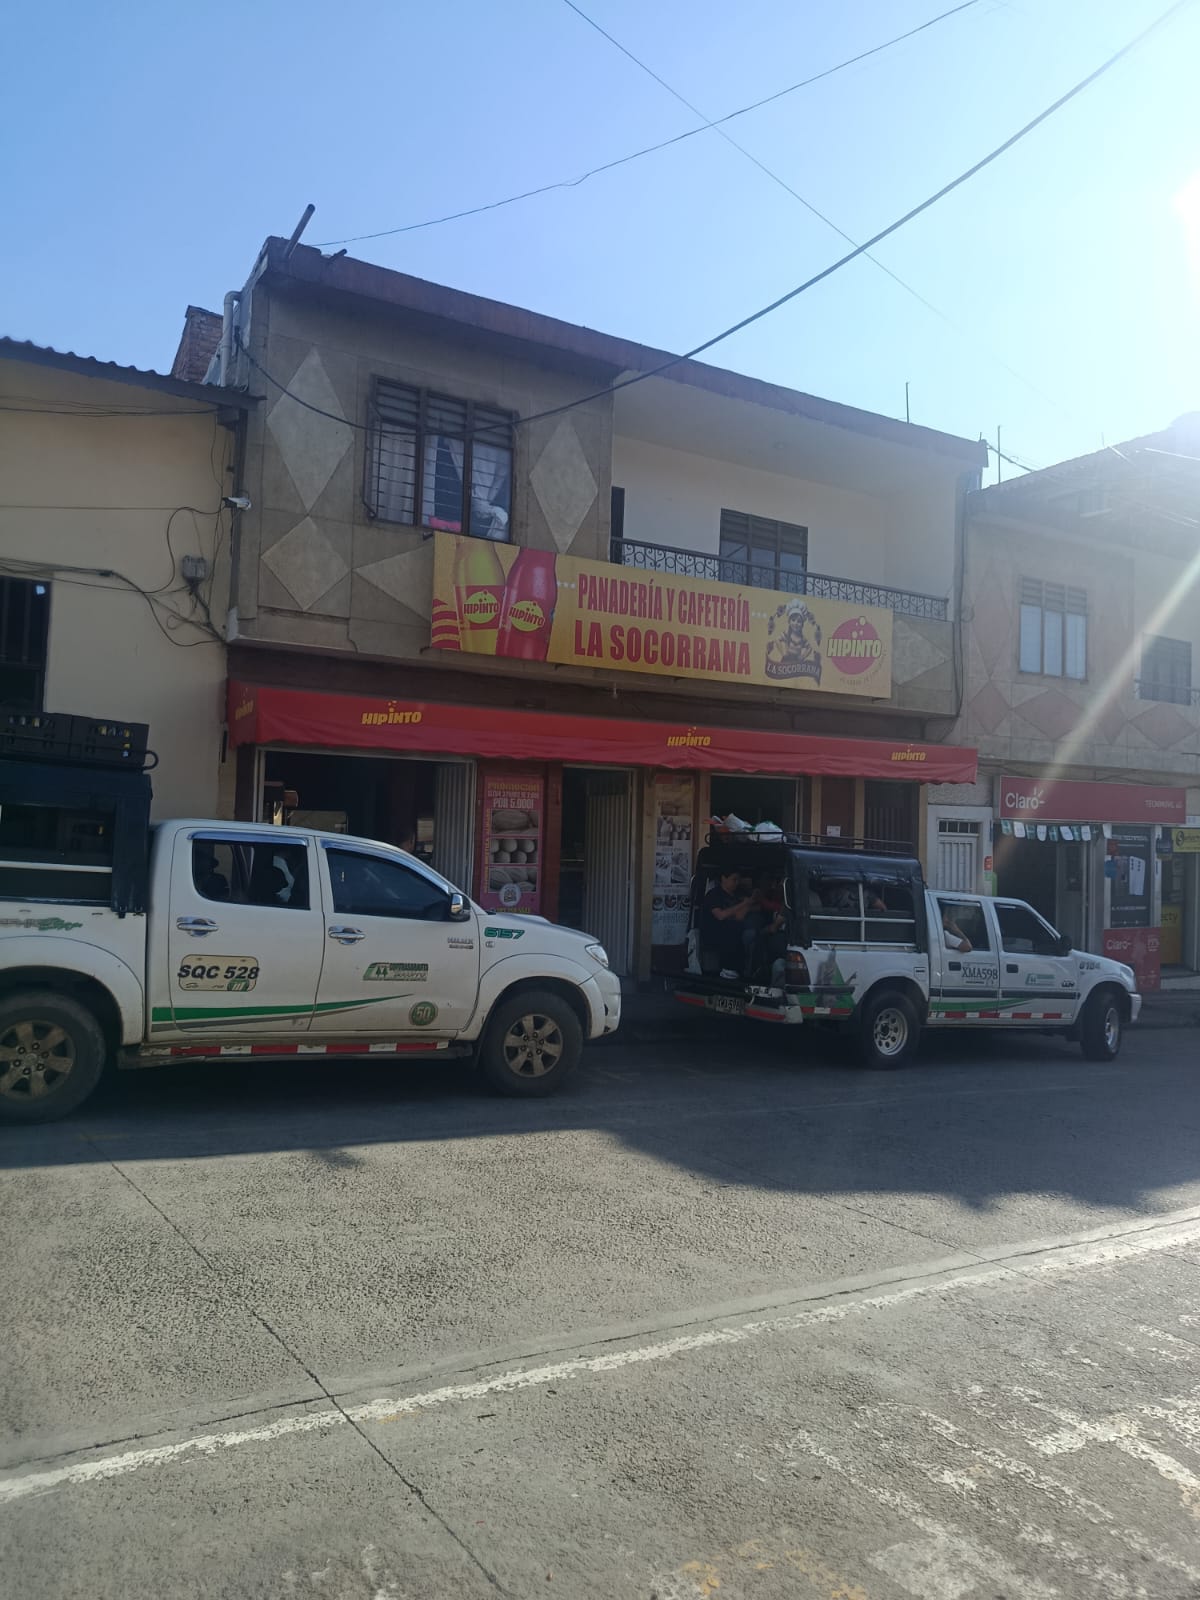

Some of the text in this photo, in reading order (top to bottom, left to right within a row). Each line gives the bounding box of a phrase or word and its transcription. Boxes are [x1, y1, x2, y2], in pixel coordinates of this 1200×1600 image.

[578, 573, 750, 632] PANADERÍA Y CAFETERÍA
[574, 620, 751, 675] LA SOCORRANA
[827, 636, 882, 658] HIPINTO
[361, 707, 423, 725] HIPINTO
[667, 732, 711, 747] HIPINTO
[484, 926, 526, 940] 6157
[177, 964, 261, 980] SQC 528
[961, 967, 998, 980] XMA598
